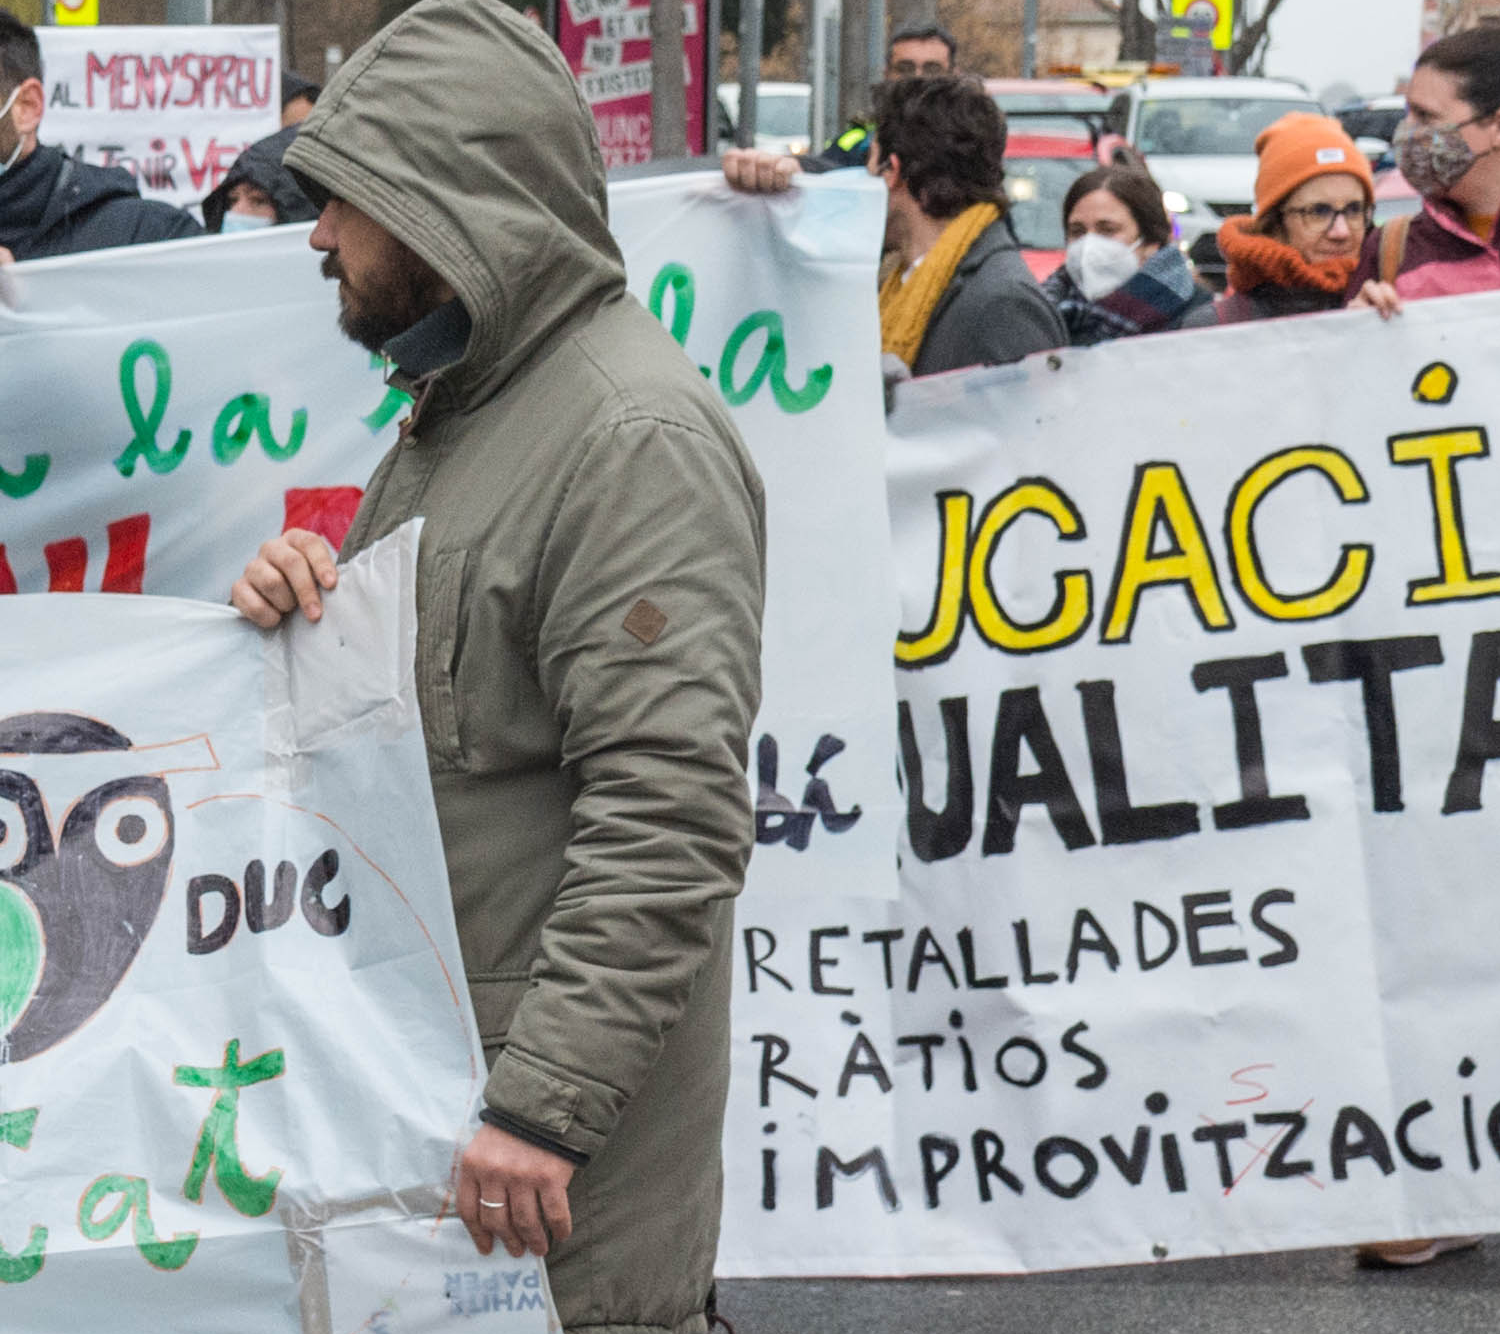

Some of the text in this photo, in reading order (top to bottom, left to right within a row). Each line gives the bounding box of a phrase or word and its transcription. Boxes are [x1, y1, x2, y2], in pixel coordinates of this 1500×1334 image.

[50, 50, 274, 111] AL MENYSPREU
[112, 337, 308, 479] la
[186, 847, 351, 956] DUC
[743, 888, 1300, 997] RETALLADES
